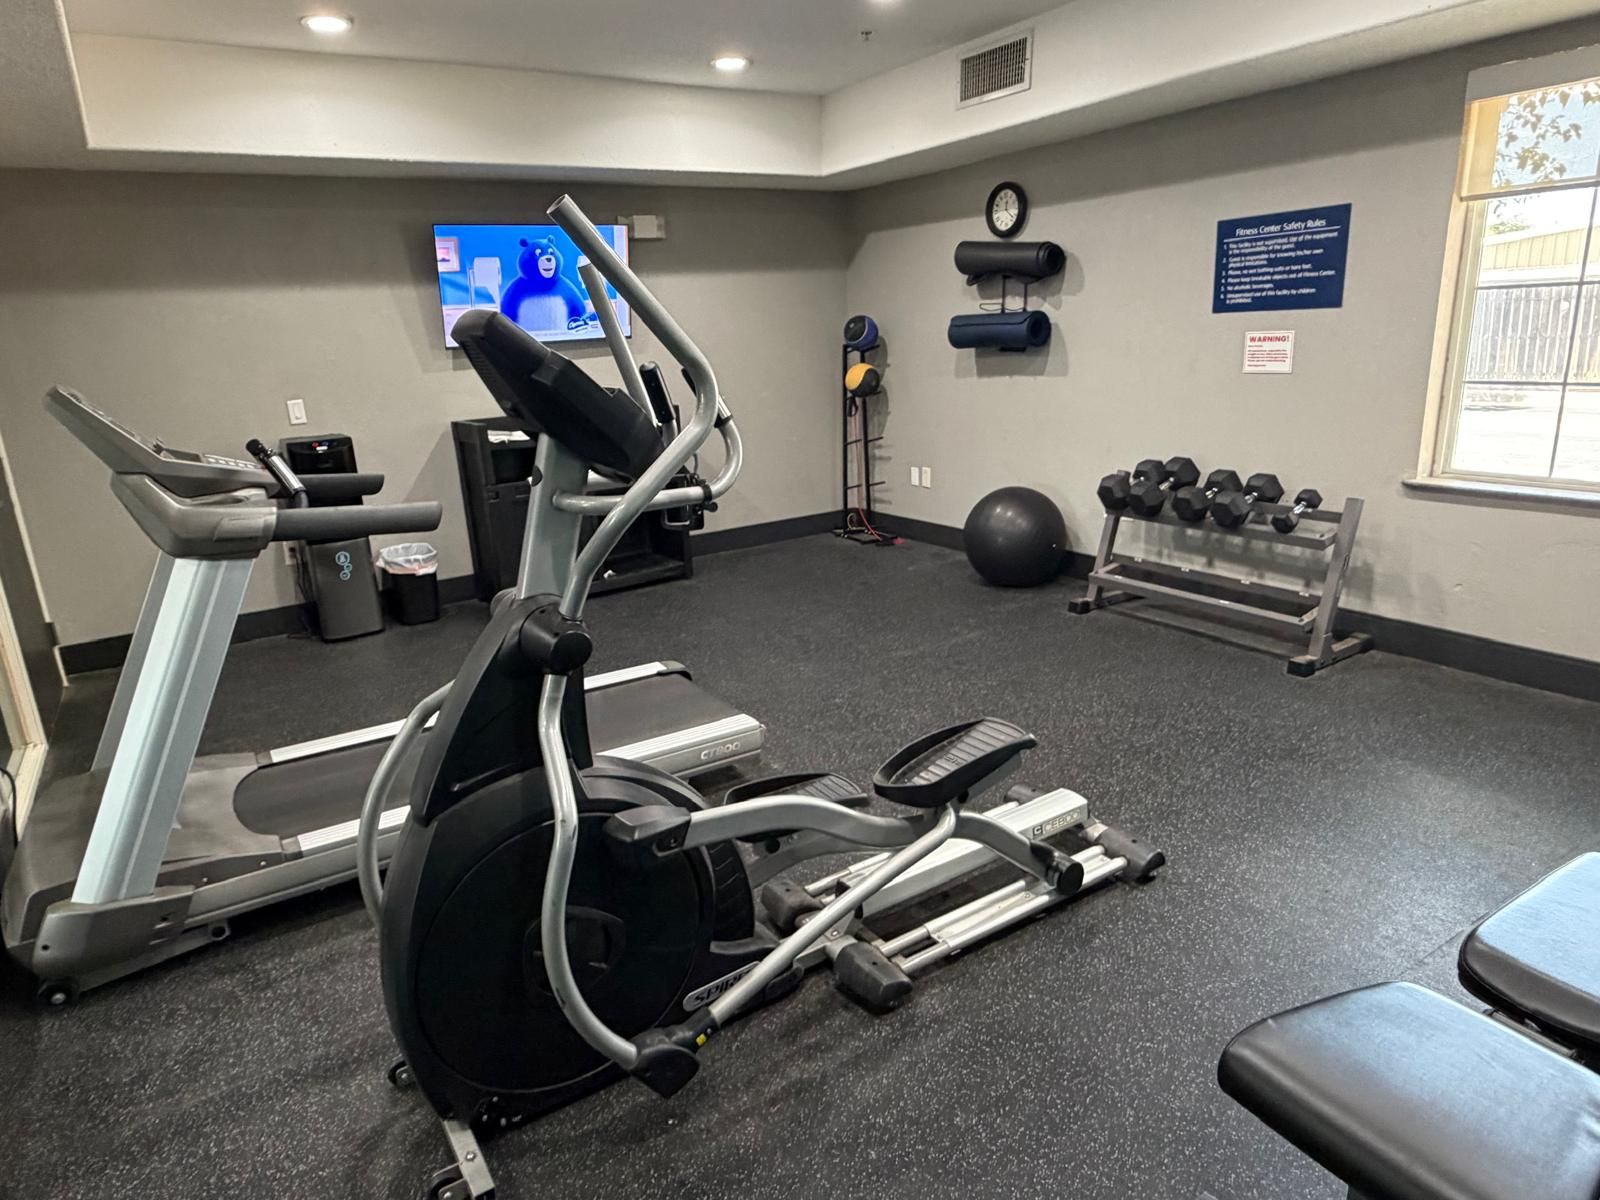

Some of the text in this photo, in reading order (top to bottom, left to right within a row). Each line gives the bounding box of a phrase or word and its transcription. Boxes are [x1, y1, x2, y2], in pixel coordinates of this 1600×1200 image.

[1236, 219, 1327, 237] Fitness Center Safety Rules
